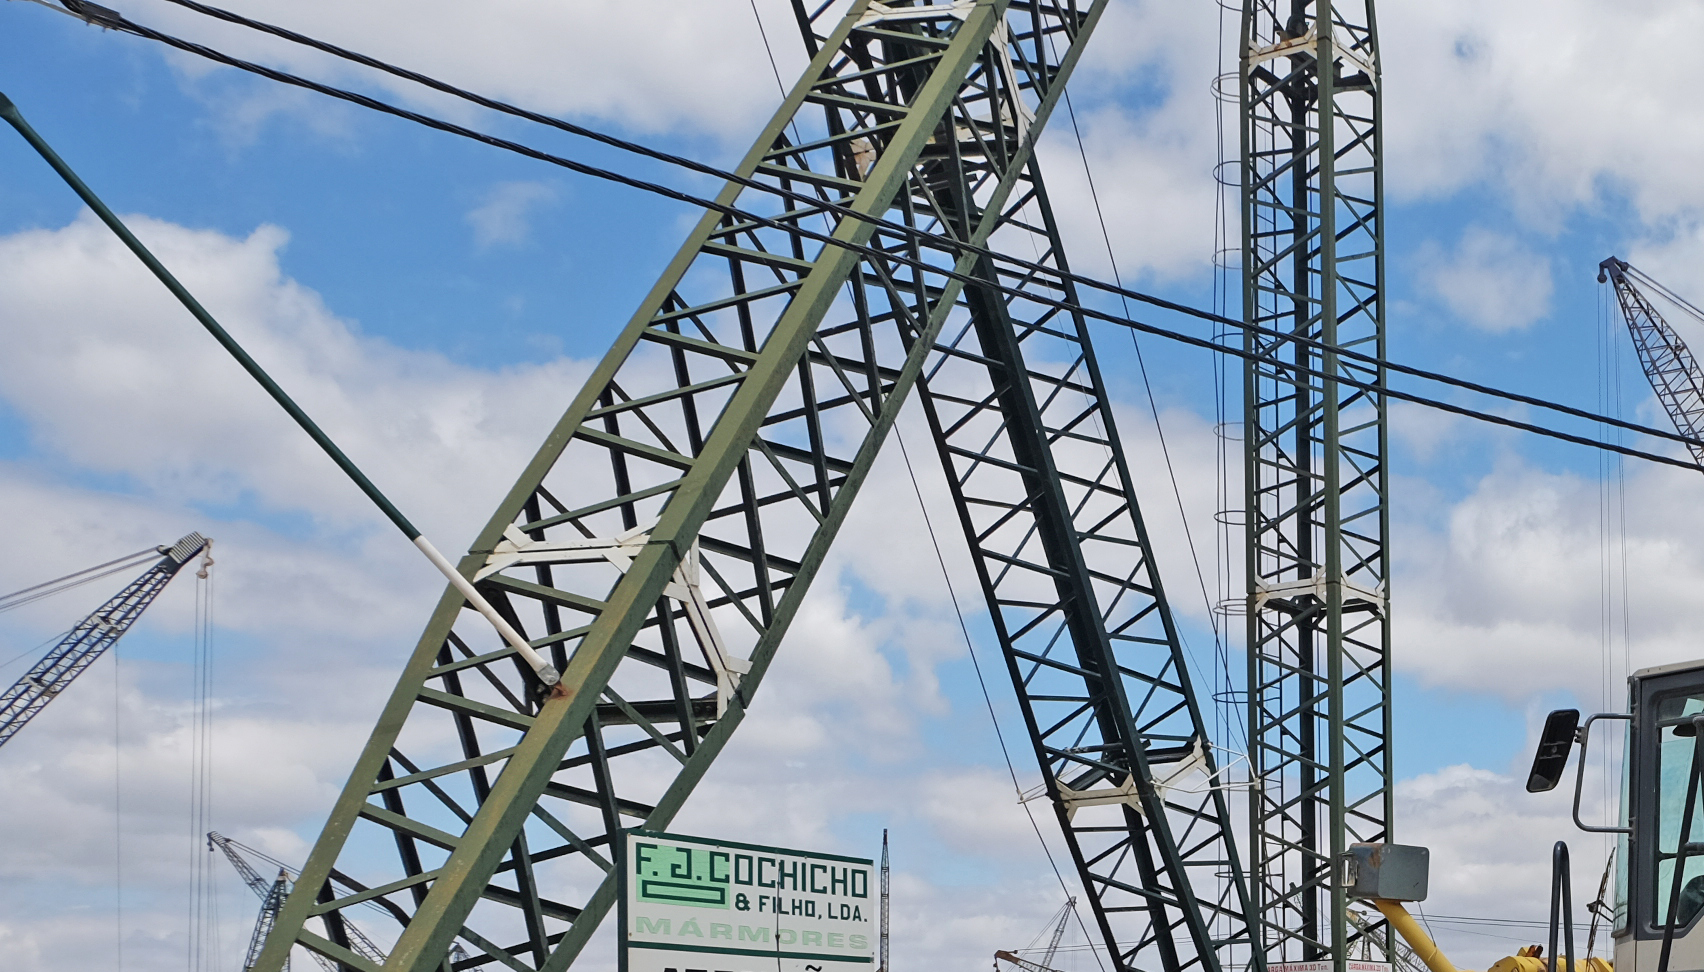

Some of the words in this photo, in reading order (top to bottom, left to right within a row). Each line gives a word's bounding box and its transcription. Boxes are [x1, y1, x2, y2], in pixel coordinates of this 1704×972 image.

[734, 892, 751, 912] &
[827, 901, 869, 923] LDA.
[635, 916, 869, 950] MÁRMORES
